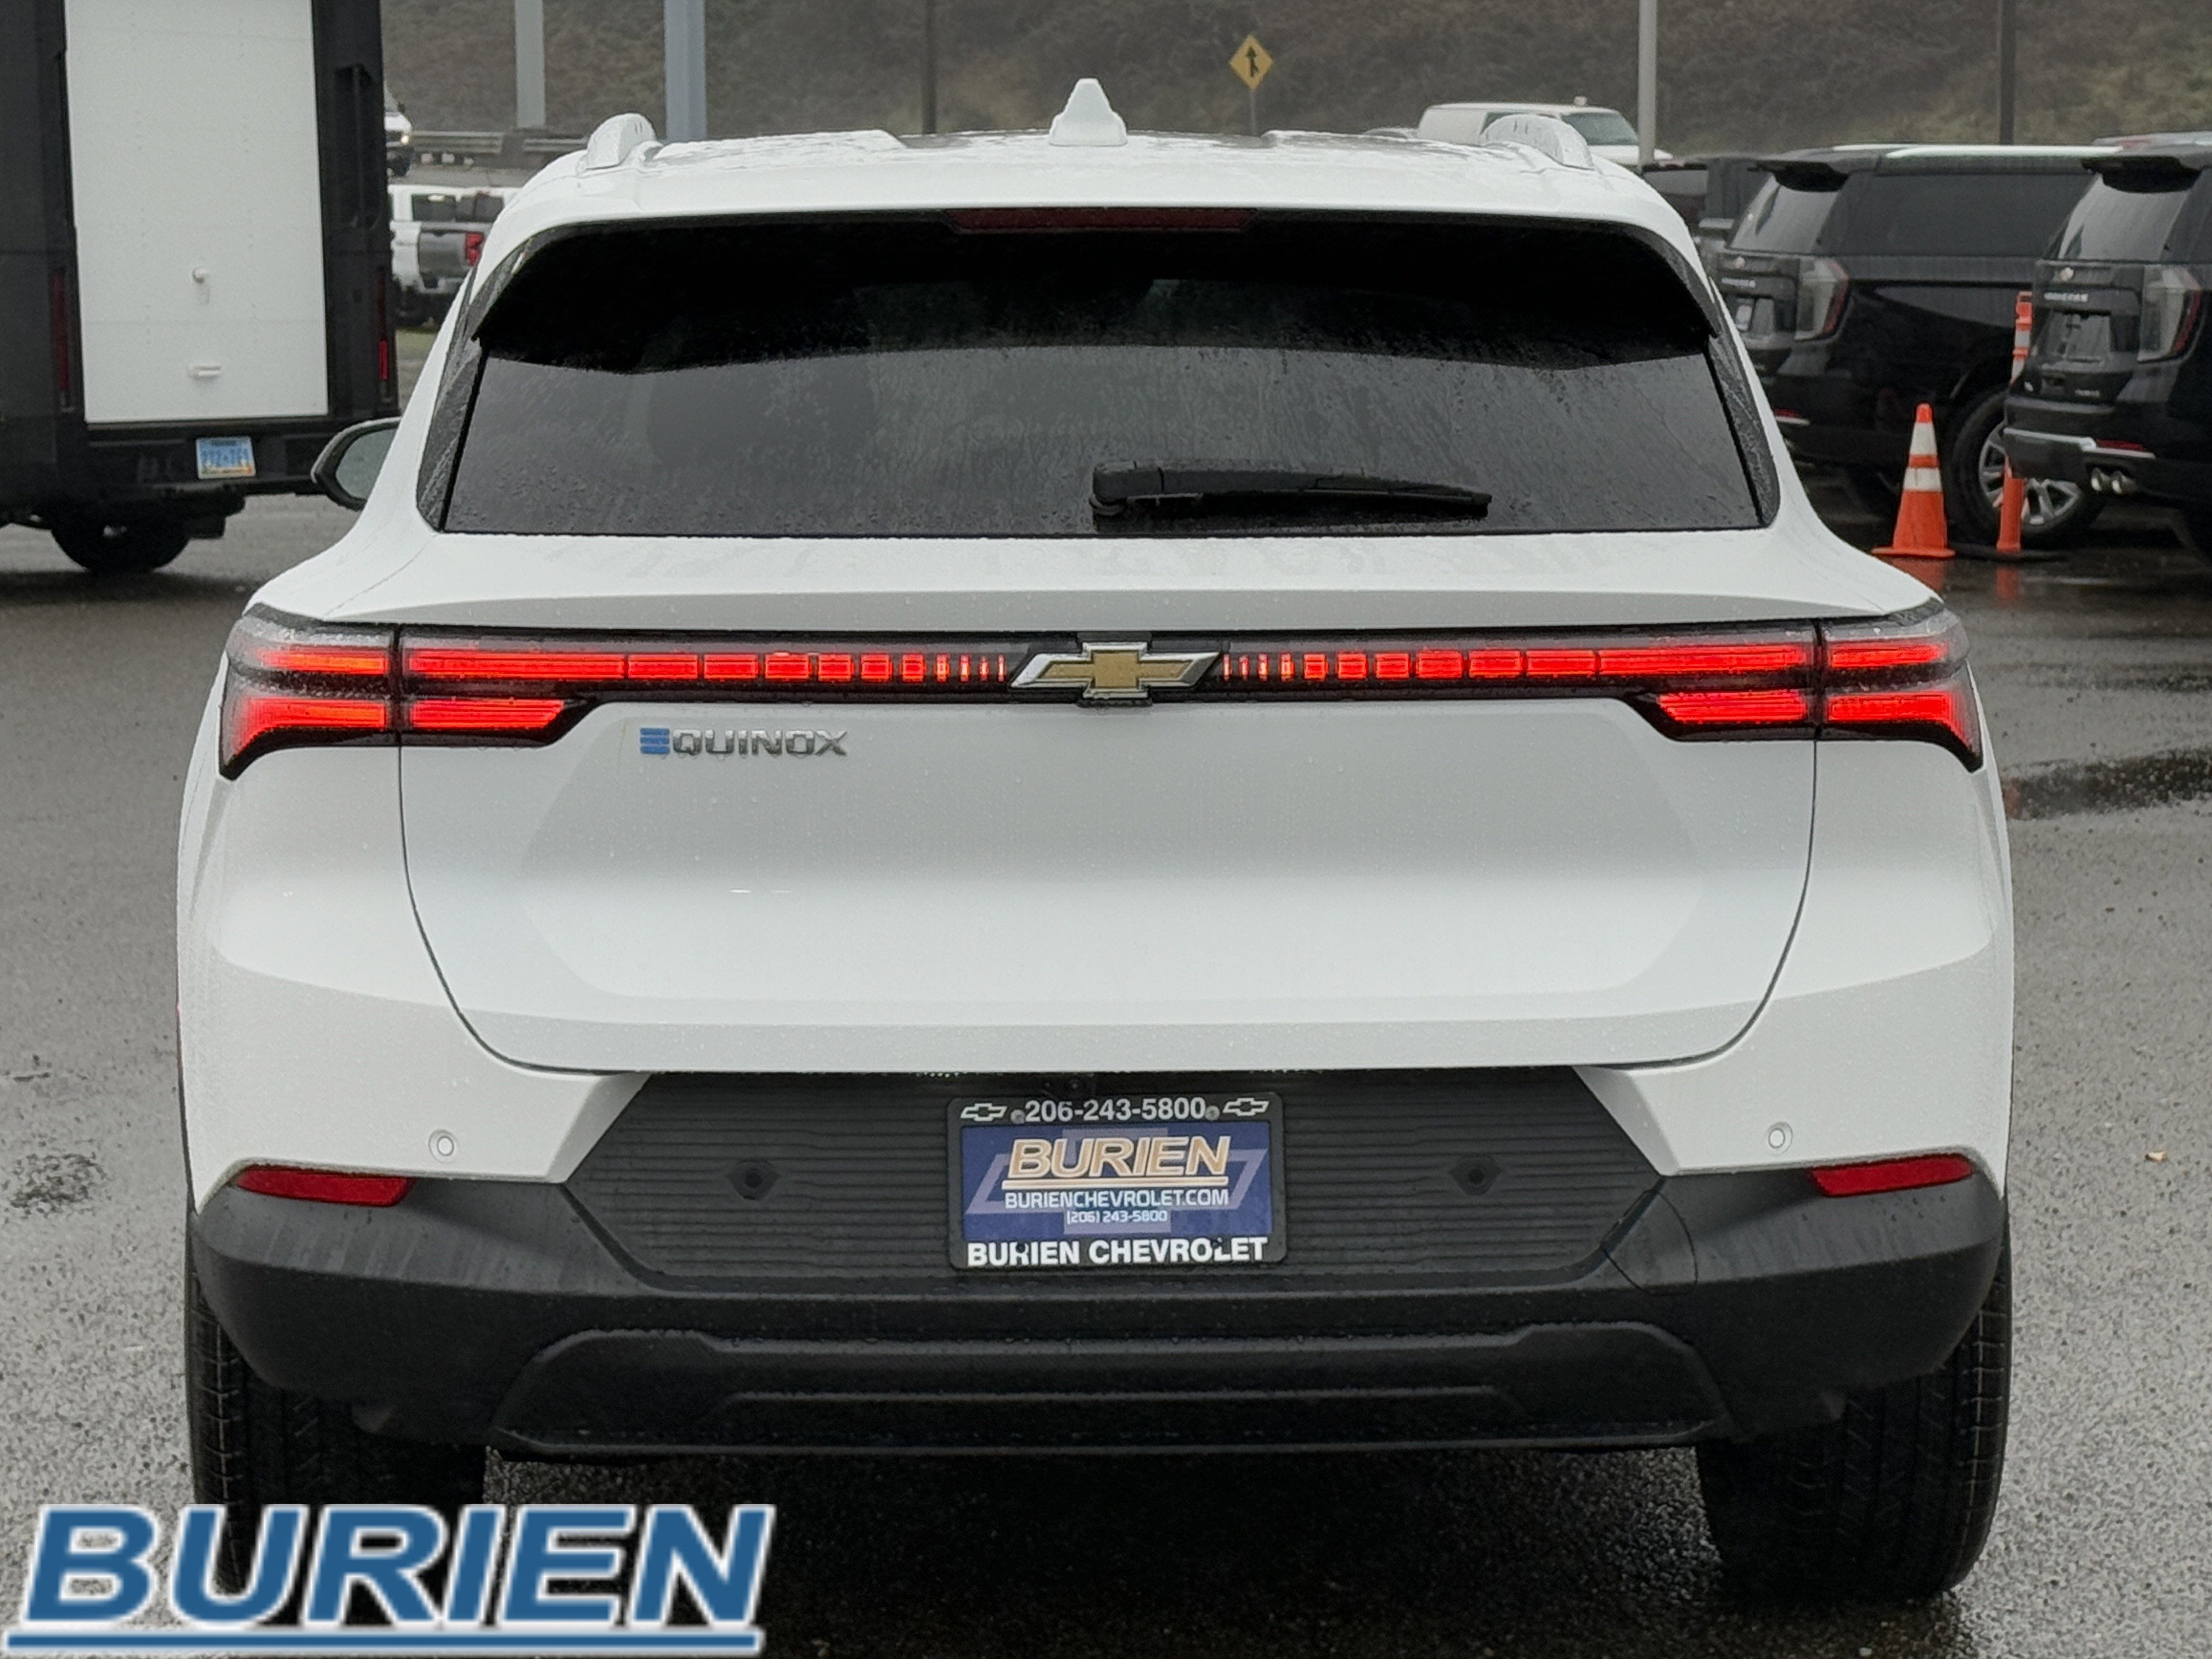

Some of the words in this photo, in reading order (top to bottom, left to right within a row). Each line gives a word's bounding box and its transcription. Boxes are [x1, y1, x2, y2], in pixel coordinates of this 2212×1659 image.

[1025, 1097, 1206, 1122] 206-243-5800
[1008, 1136, 1231, 1178] BURIEN
[1005, 1189, 1229, 1209] BURIENCHEVROLET.COM
[1103, 1210, 1168, 1223] 243-5800
[967, 1240, 1080, 1267] BURIEN
[1089, 1237, 1268, 1265] CHEVROLET
